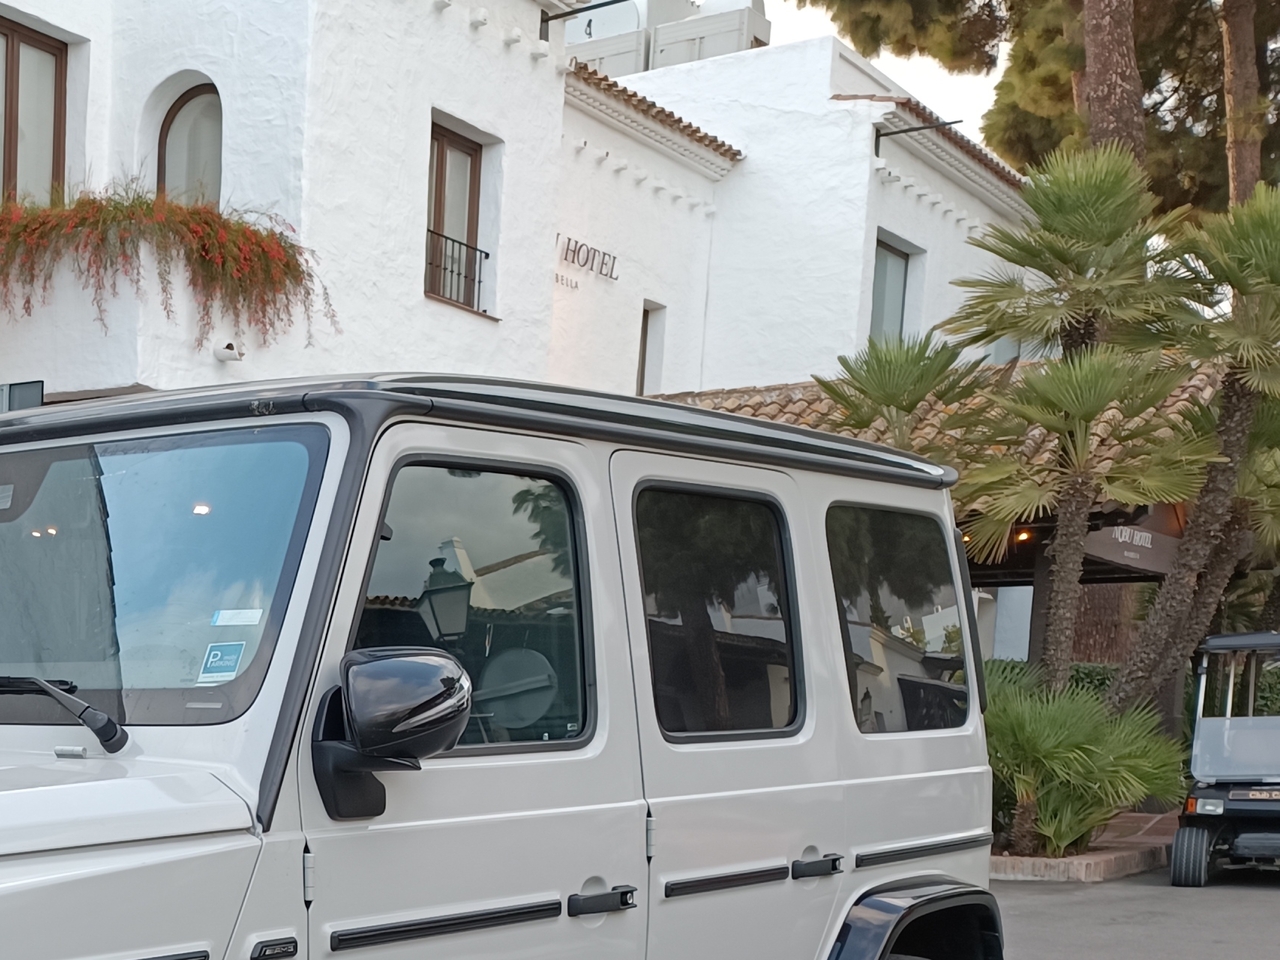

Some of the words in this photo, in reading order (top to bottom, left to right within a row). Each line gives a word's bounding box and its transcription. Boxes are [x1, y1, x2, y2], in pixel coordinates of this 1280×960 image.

[564, 236, 619, 281] HOTEL
[1112, 526, 1133, 543] NOBU
[1133, 530, 1152, 548] HOTEL
[1249, 791, 1270, 799] Club
